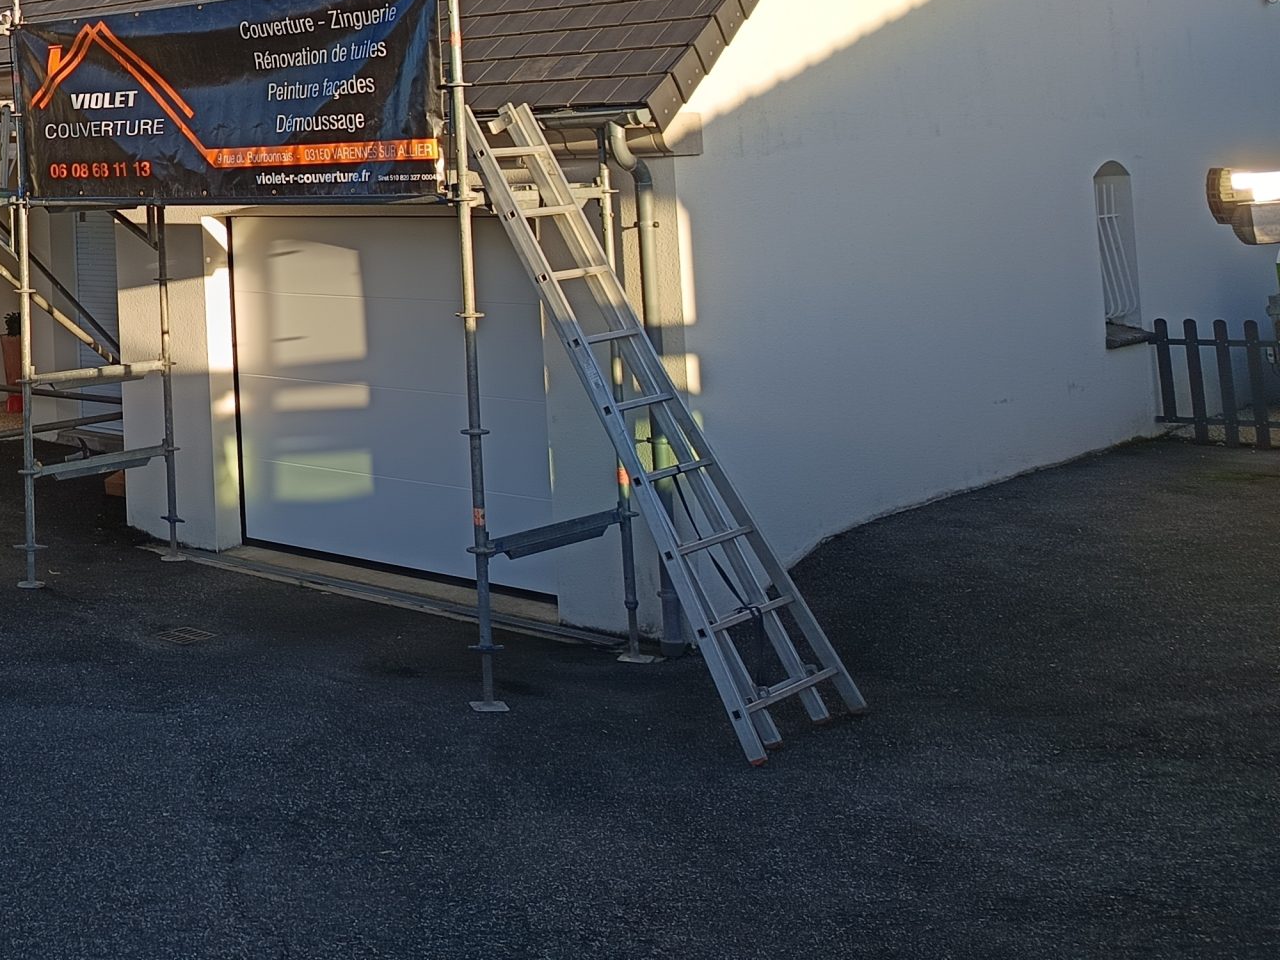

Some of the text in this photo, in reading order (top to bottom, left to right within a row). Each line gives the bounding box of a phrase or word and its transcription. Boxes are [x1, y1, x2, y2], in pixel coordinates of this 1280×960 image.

[239, 17, 315, 39] Couverture
[327, 3, 397, 30] Zinguerie
[254, 40, 387, 70] Rénovation de tuiles
[268, 74, 375, 101] Peinture façades
[70, 90, 138, 110] VIOLET
[44, 118, 165, 139] COUVERTURE
[276, 112, 365, 133] Démoussage
[223, 154, 235, 163] rue
[333, 146, 377, 159] VARENNES
[379, 144, 396, 159] SUR
[397, 143, 433, 157] ALLIER
[50, 163, 67, 178] 06
[71, 163, 89, 178] 08
[113, 162, 127, 177] 11
[133, 161, 150, 176] 13
[256, 170, 370, 184] violet-r-couverture.fr
